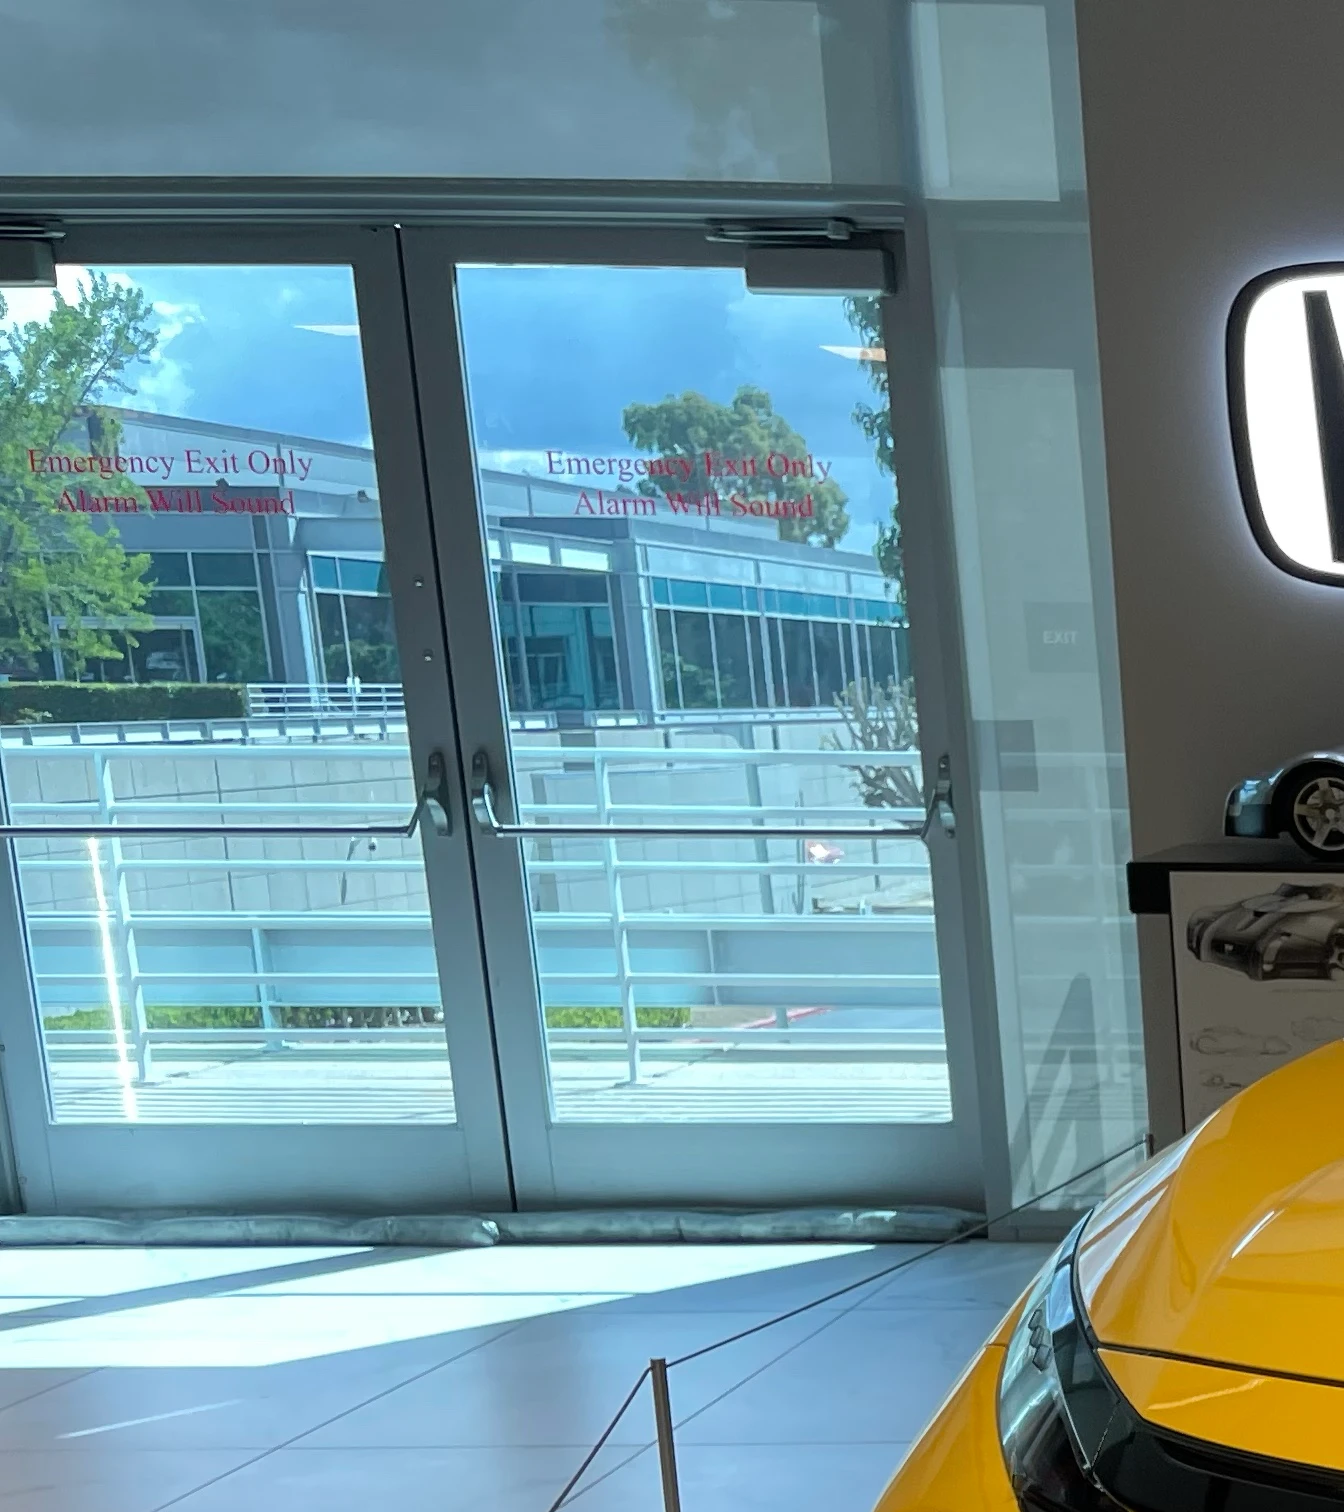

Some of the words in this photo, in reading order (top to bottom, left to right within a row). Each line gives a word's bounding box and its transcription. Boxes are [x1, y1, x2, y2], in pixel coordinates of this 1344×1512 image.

[28, 448, 175, 480] Emergency
[185, 448, 241, 474] Exit
[248, 448, 314, 481] Only
[545, 450, 695, 482] Emergency
[704, 451, 757, 478] Exit
[766, 451, 833, 485] Only
[57, 489, 140, 514] Alarm
[146, 489, 201, 513] Will
[212, 489, 296, 515] Sound
[574, 490, 657, 517] Alarm
[665, 490, 721, 517] Will
[731, 492, 816, 519] Sound
[1043, 630, 1079, 645] EXIT
